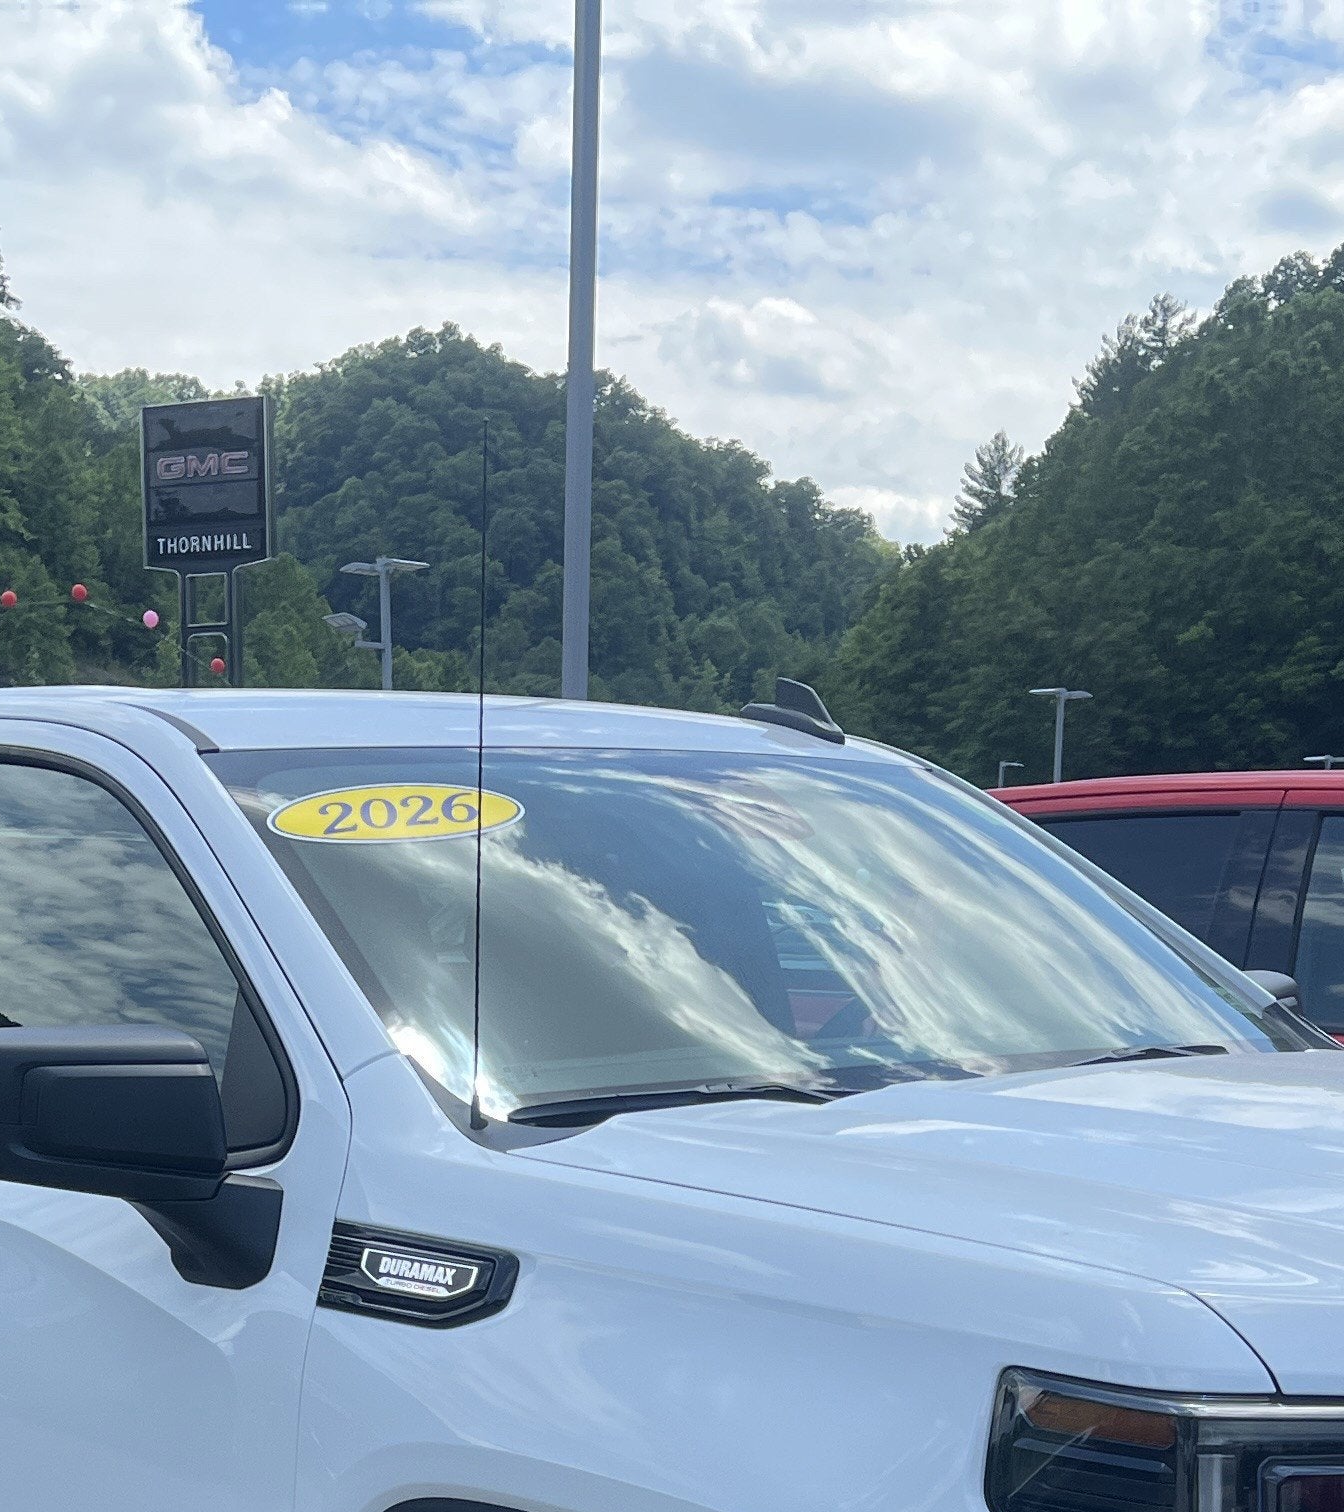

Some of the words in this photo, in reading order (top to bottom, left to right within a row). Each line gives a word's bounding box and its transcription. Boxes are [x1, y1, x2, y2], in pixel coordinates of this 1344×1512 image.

[157, 451, 249, 480] GMC
[157, 533, 252, 554] THORNHILL
[318, 792, 479, 835] 2026
[379, 1256, 456, 1286] DURAMAX
